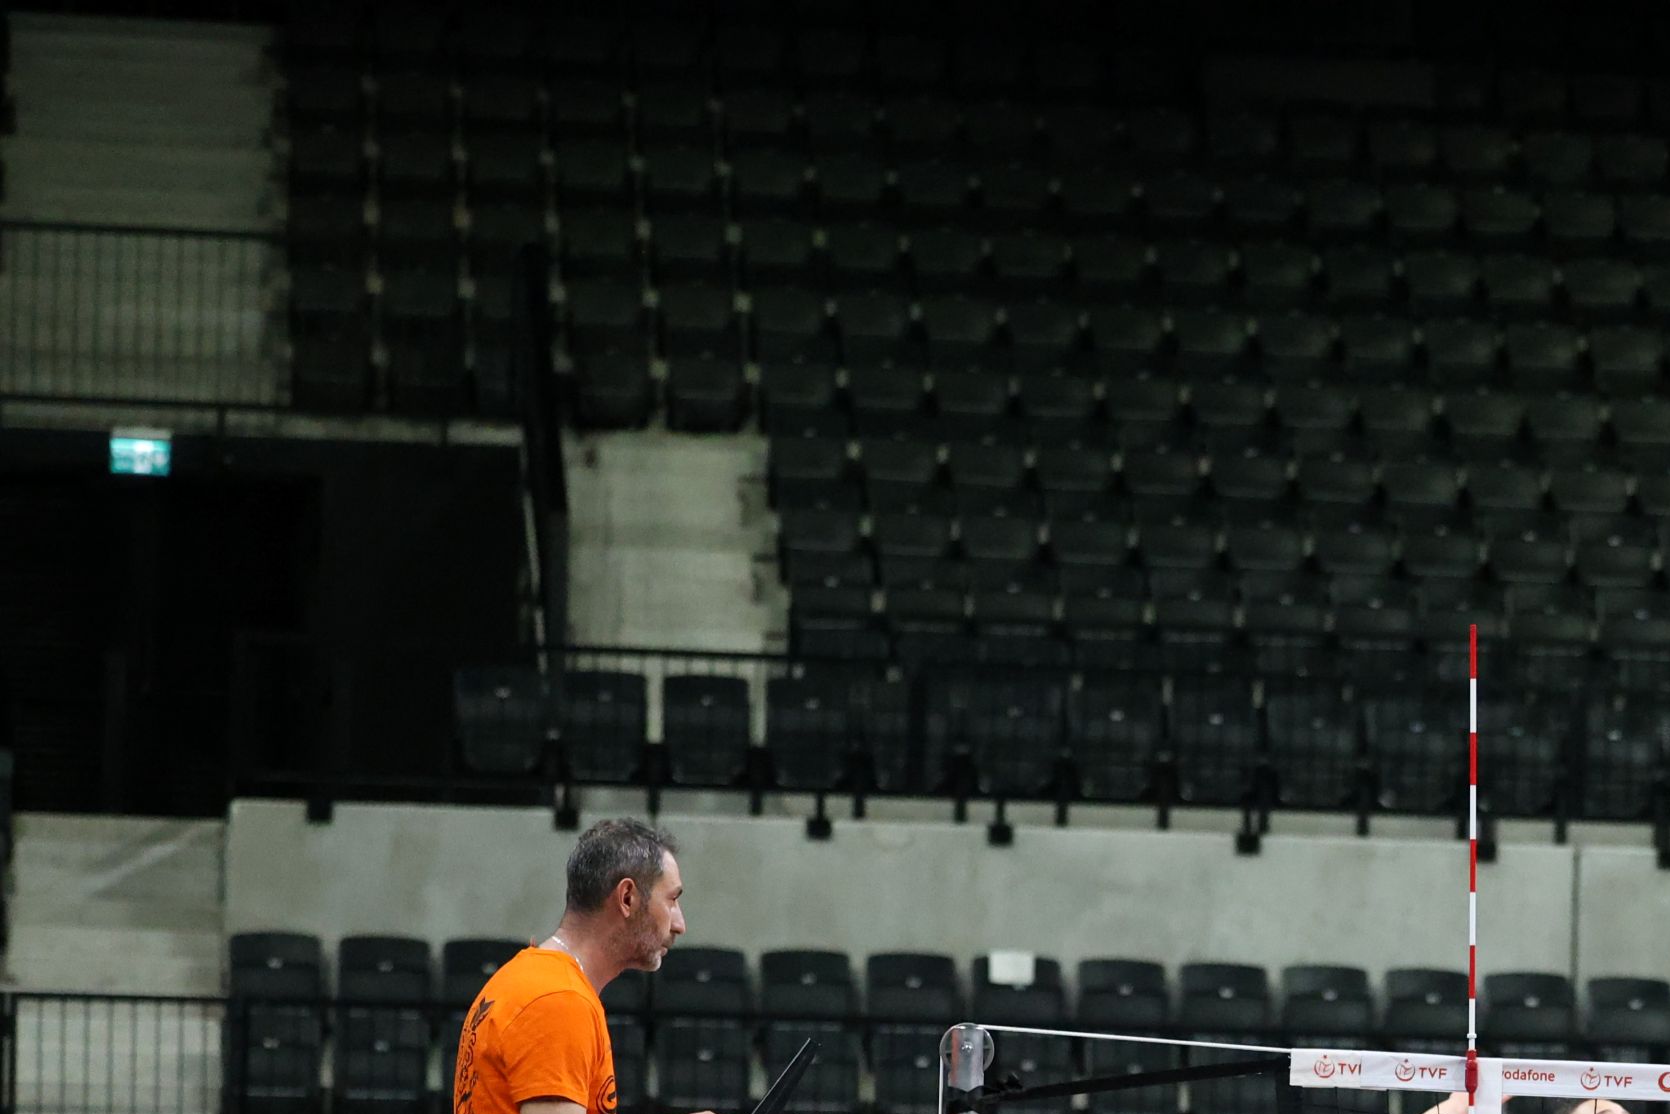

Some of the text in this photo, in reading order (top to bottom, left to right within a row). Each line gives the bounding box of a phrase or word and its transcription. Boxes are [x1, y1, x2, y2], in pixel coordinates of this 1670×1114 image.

[1338, 1063, 1361, 1075] TV
[1419, 1067, 1447, 1079] TVF
[1604, 1075, 1632, 1087] TVF
